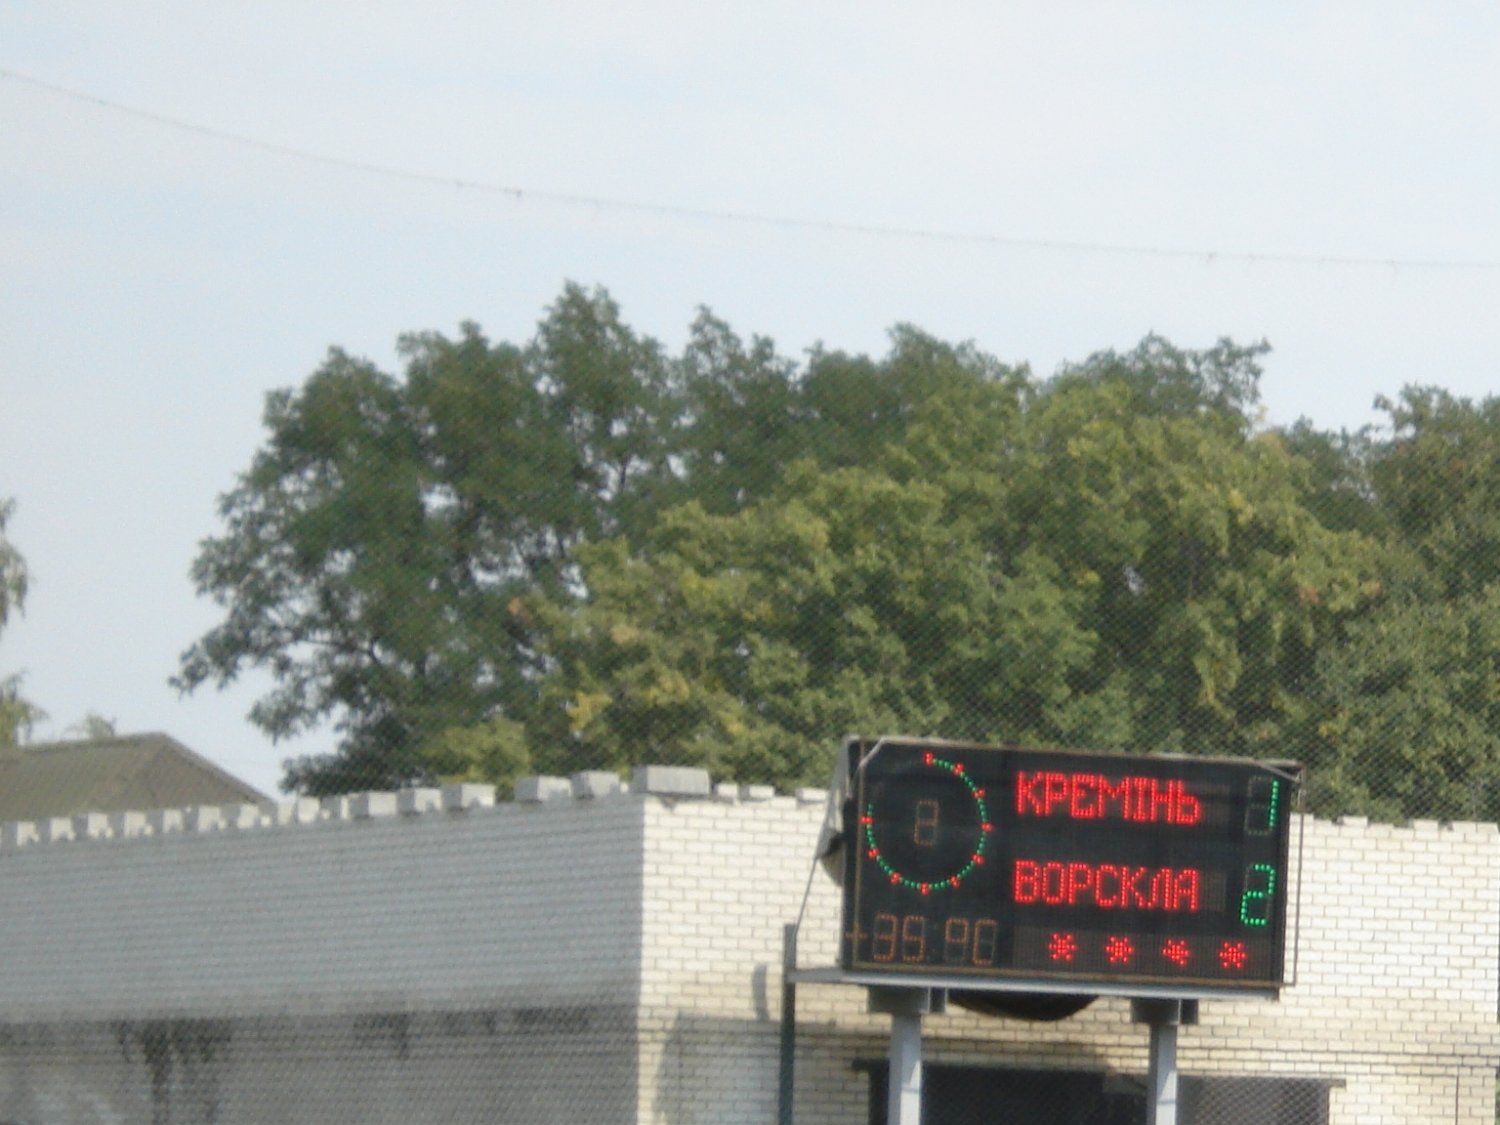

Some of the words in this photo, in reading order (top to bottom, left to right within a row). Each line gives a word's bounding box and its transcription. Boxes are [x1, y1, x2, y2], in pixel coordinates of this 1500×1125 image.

[1016, 770, 1200, 826] КРЕМІНЬ
[1013, 860, 1199, 912] ВОРСКЛА
[1240, 863, 1276, 926] 2
